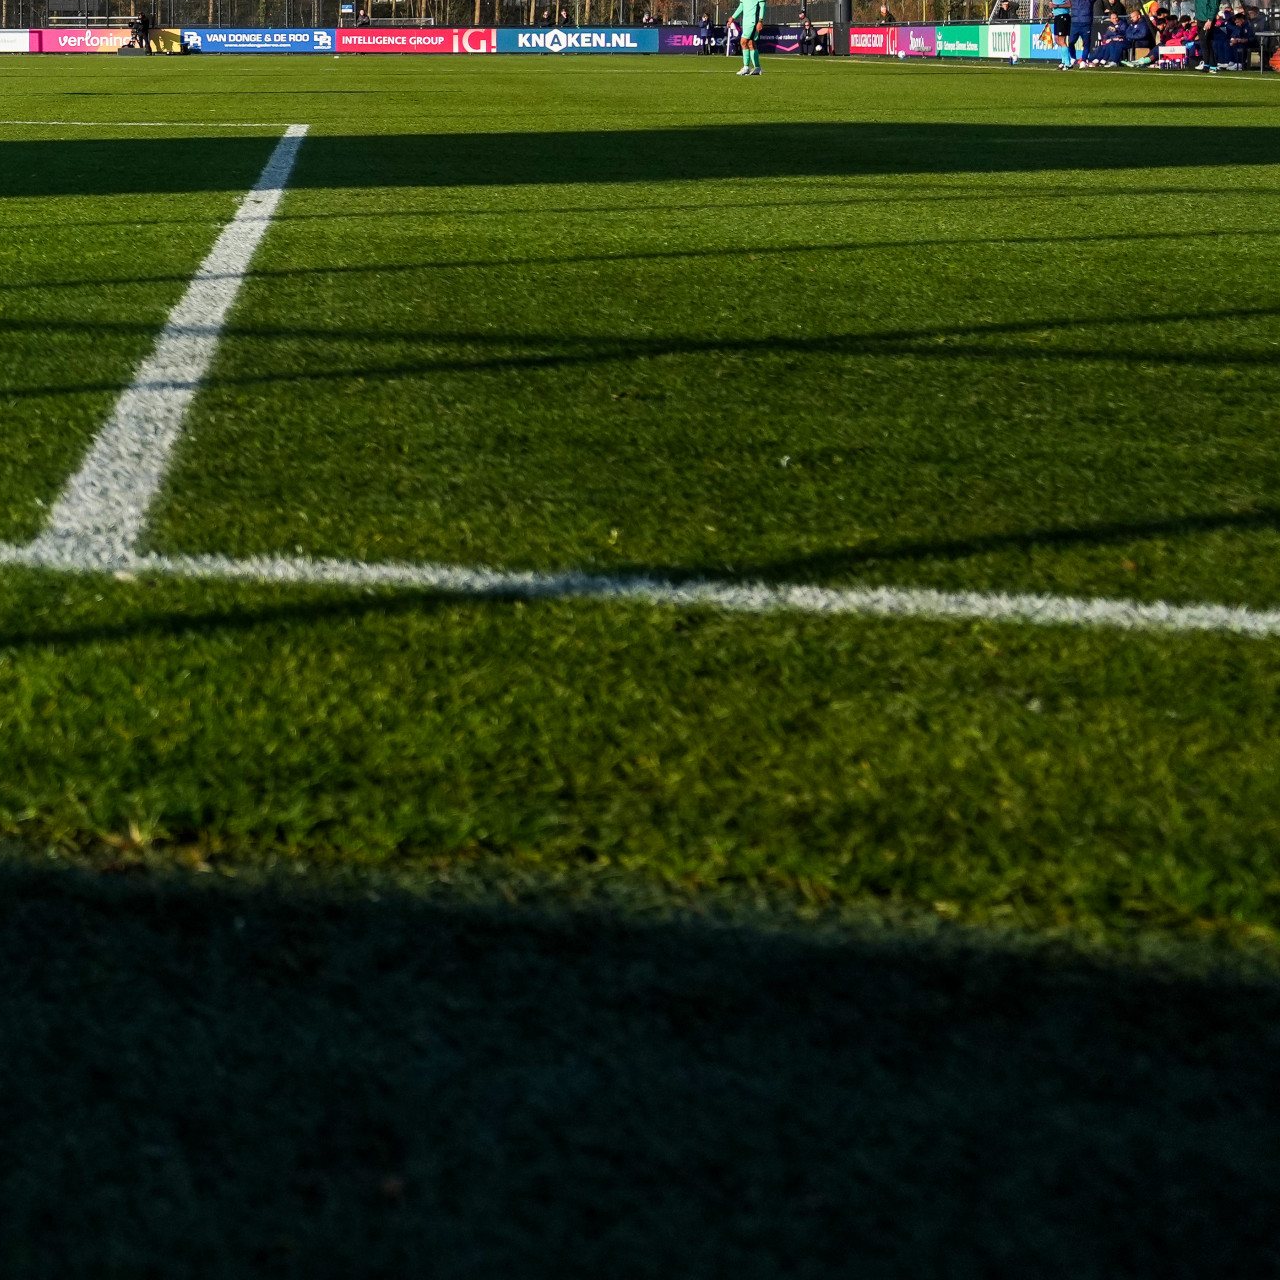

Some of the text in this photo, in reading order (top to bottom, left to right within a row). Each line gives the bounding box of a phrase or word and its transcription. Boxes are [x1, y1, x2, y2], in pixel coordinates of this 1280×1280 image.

[206, 33, 310, 42] VAN DONGE & DE ROO
[342, 36, 407, 45] INTELLIGENCE
[409, 36, 445, 45] GROUP
[518, 32, 638, 48] KNAKEN.NL
